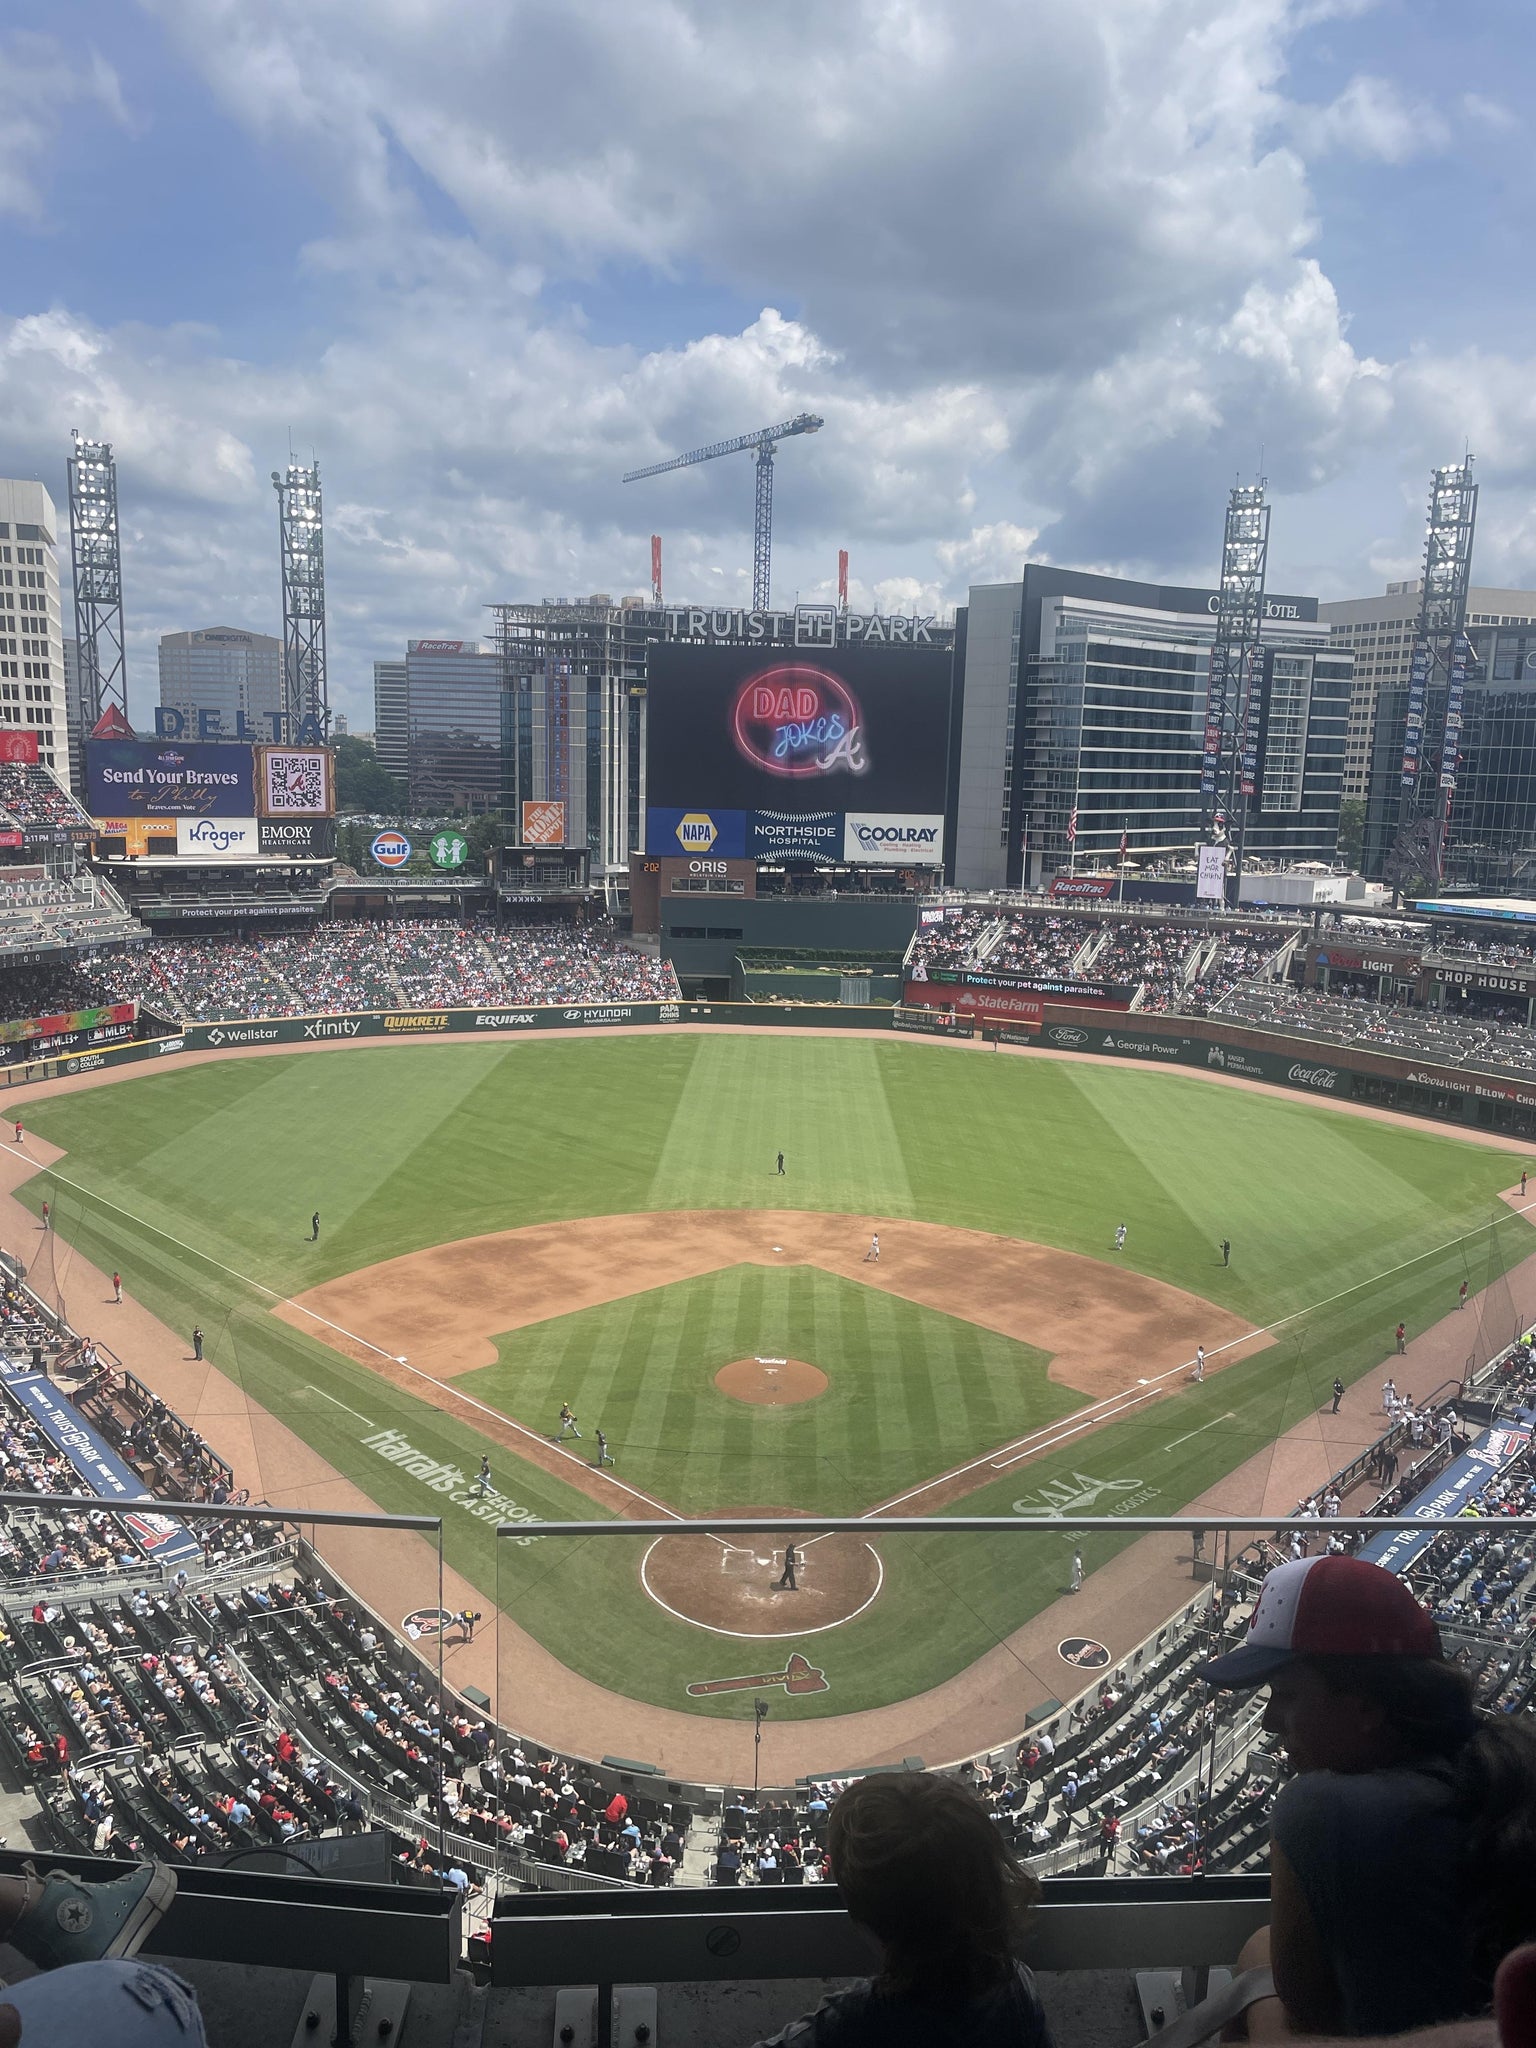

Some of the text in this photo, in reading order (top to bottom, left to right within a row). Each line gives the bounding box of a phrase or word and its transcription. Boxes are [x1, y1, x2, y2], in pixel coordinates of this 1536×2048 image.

[665, 609, 935, 642] TRUIST PARK
[421, 641, 459, 651] RaceTrac
[753, 687, 819, 719] DAD
[155, 706, 326, 741] DELTA
[775, 713, 845, 757] JOKES
[103, 768, 239, 785] Send Your Braves
[128, 784, 218, 813] to Philly
[528, 806, 545, 822] THE
[105, 821, 128, 830] MEGA
[523, 802, 565, 842] HOME
[189, 820, 246, 851] Kroger
[261, 826, 313, 839] EMORY
[539, 817, 563, 842] DEPOT
[682, 824, 711, 841] NAPA
[754, 825, 837, 838] NORTHSIDE
[858, 826, 939, 843] COOLRAY
[24, 835, 38, 843] 3:11
[39, 834, 49, 842] PM
[768, 837, 821, 846] HOSPITAL
[374, 843, 408, 855] Gulf
[689, 860, 728, 874] ORIS
[1206, 856, 1219, 864] EAT
[1205, 864, 1219, 872] MOR
[1054, 882, 1106, 894] RaceTrac
[182, 908, 213, 917] Protect
[213, 909, 233, 918] your
[234, 907, 248, 917] pet
[248, 906, 278, 916] against
[278, 905, 316, 915] parasites.
[1362, 959, 1394, 973] LIGHT
[966, 975, 997, 985] Protect
[998, 979, 1016, 988] your
[1017, 980, 1032, 991] pet
[1032, 982, 1063, 993] against
[1064, 984, 1105, 996] parasites.
[1435, 969, 1527, 993] CHOP HOUSE
[584, 1008, 632, 1019] HYUNDAI
[659, 1004, 679, 1012] PAPA
[659, 1011, 680, 1019] JOHNS
[384, 1015, 449, 1028] QUIKRETE
[475, 1014, 535, 1027] EQUIFAX
[104, 1024, 132, 1038] MLB+
[227, 1029, 279, 1041] Wellstar
[303, 1018, 361, 1039] xfinity
[1055, 1029, 1082, 1042] Ford
[51, 1034, 79, 1047] MLB+
[1117, 1039, 1179, 1055] Georgia Power
[79, 1054, 100, 1063] SOUTH
[79, 1058, 105, 1069] COLLEGE
[1227, 1054, 1246, 1064] KAISER
[1227, 1061, 1264, 1076] PERMANENTE
[1288, 1063, 1339, 1089] Coca-Cola
[1418, 1072, 1445, 1087] Coors
[1445, 1080, 1471, 1093] LIGHT
[1475, 1085, 1506, 1100] BELOW
[48, 1409, 79, 1434] TRUIST
[74, 1441, 102, 1463] PARK
[1111, 1486, 1162, 1516] LOGISTICS
[1430, 1489, 1460, 1511] PARK
[1388, 1545, 1400, 1555] TO
